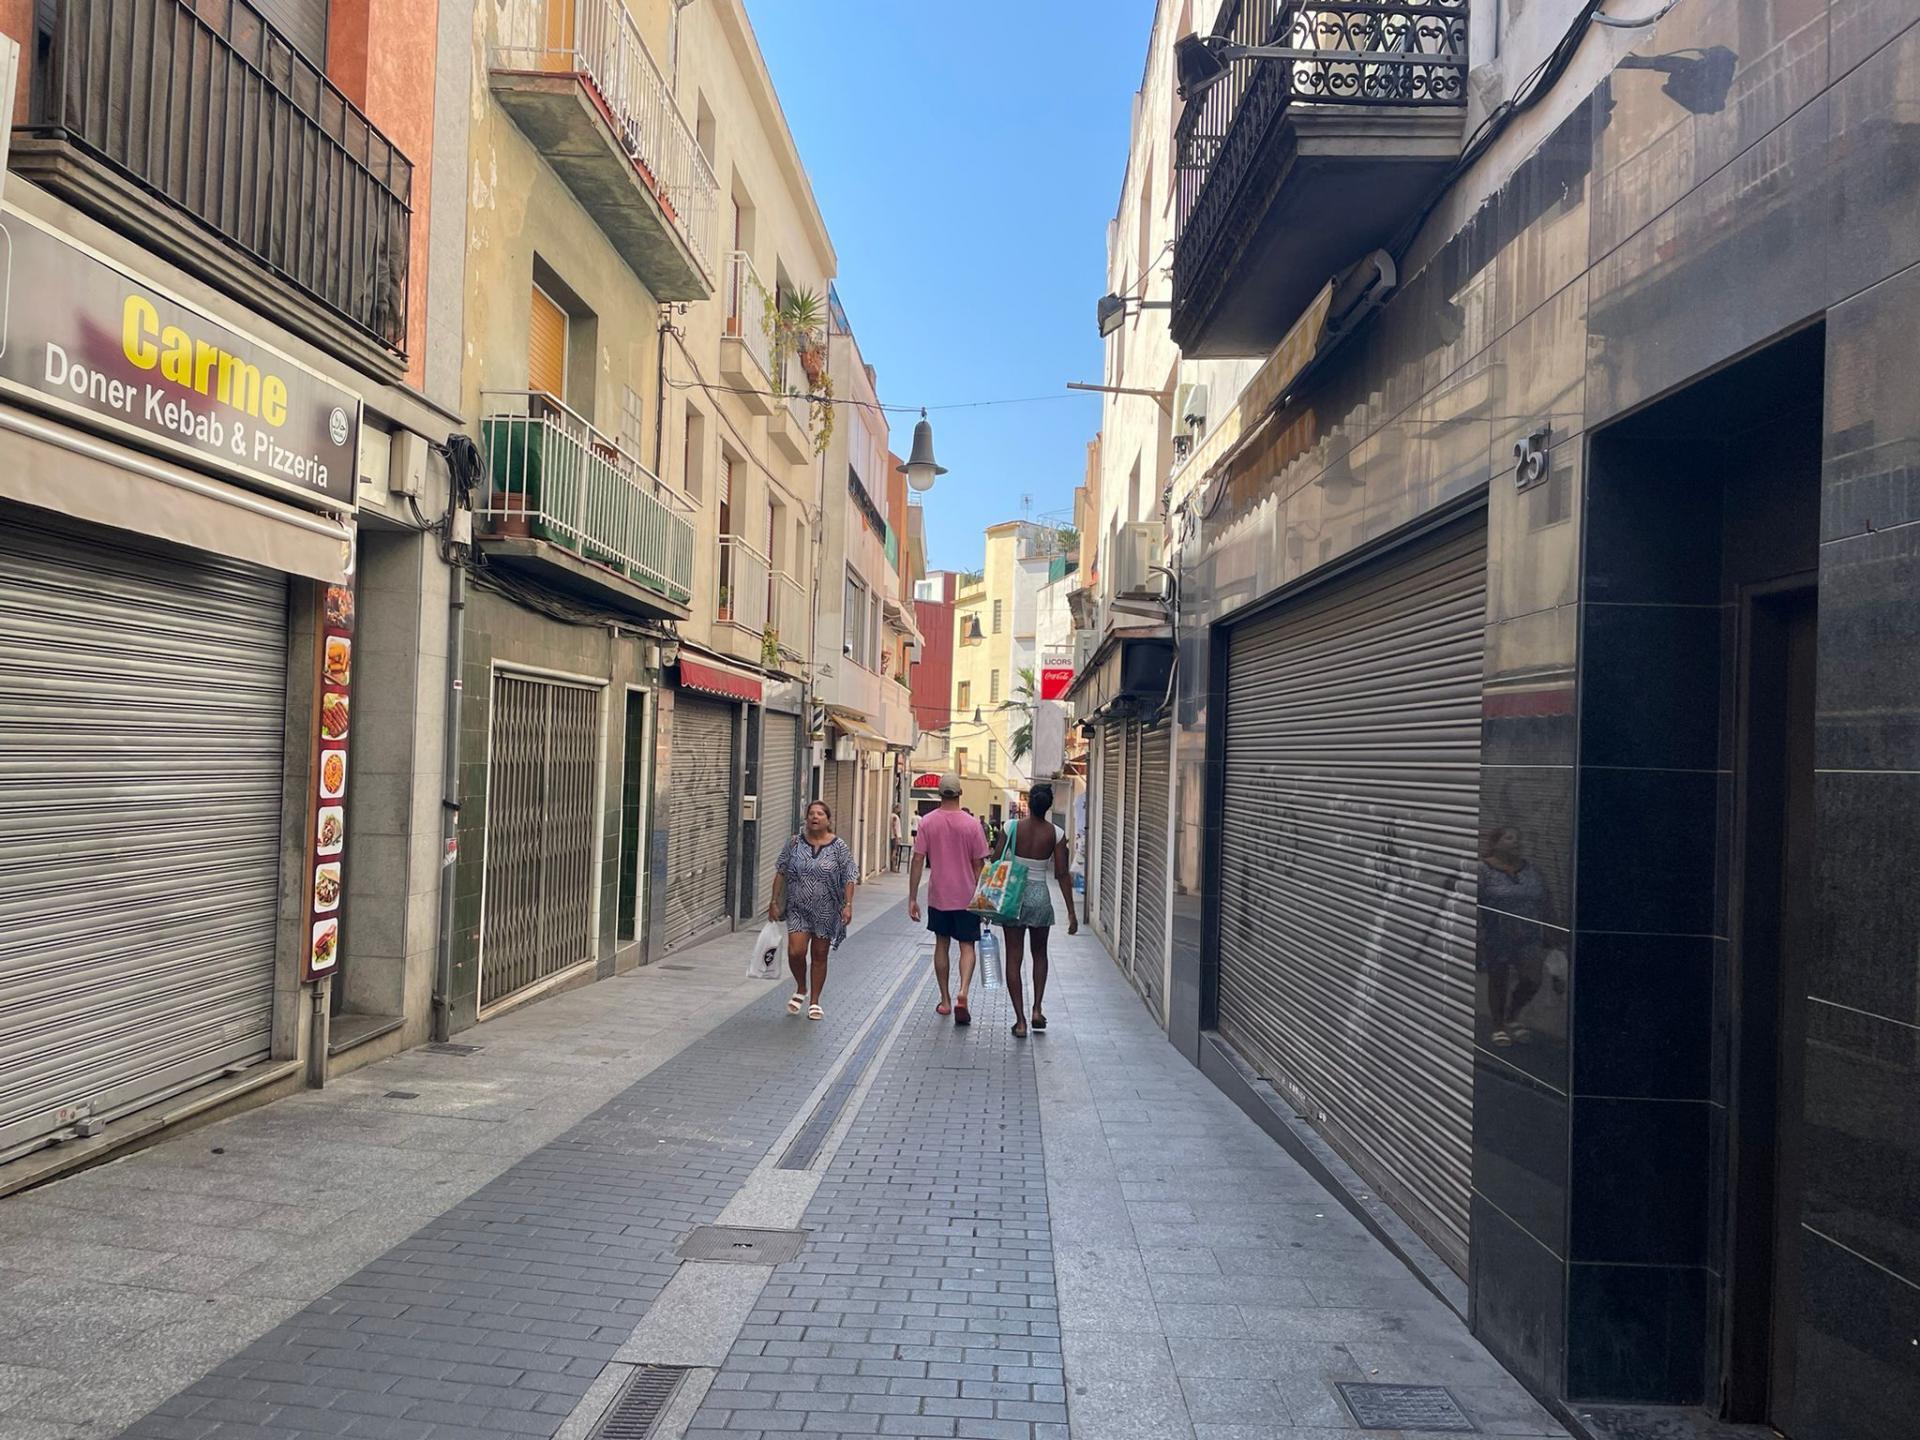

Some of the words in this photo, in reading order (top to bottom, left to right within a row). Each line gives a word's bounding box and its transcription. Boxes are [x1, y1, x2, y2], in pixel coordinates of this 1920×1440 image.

[45, 342, 137, 413] Doner
[145, 384, 224, 447] Kebab
[231, 422, 247, 456] &
[254, 431, 328, 488] Pizzeria
[122, 295, 287, 427] Carme
[1513, 430, 1546, 488] 25
